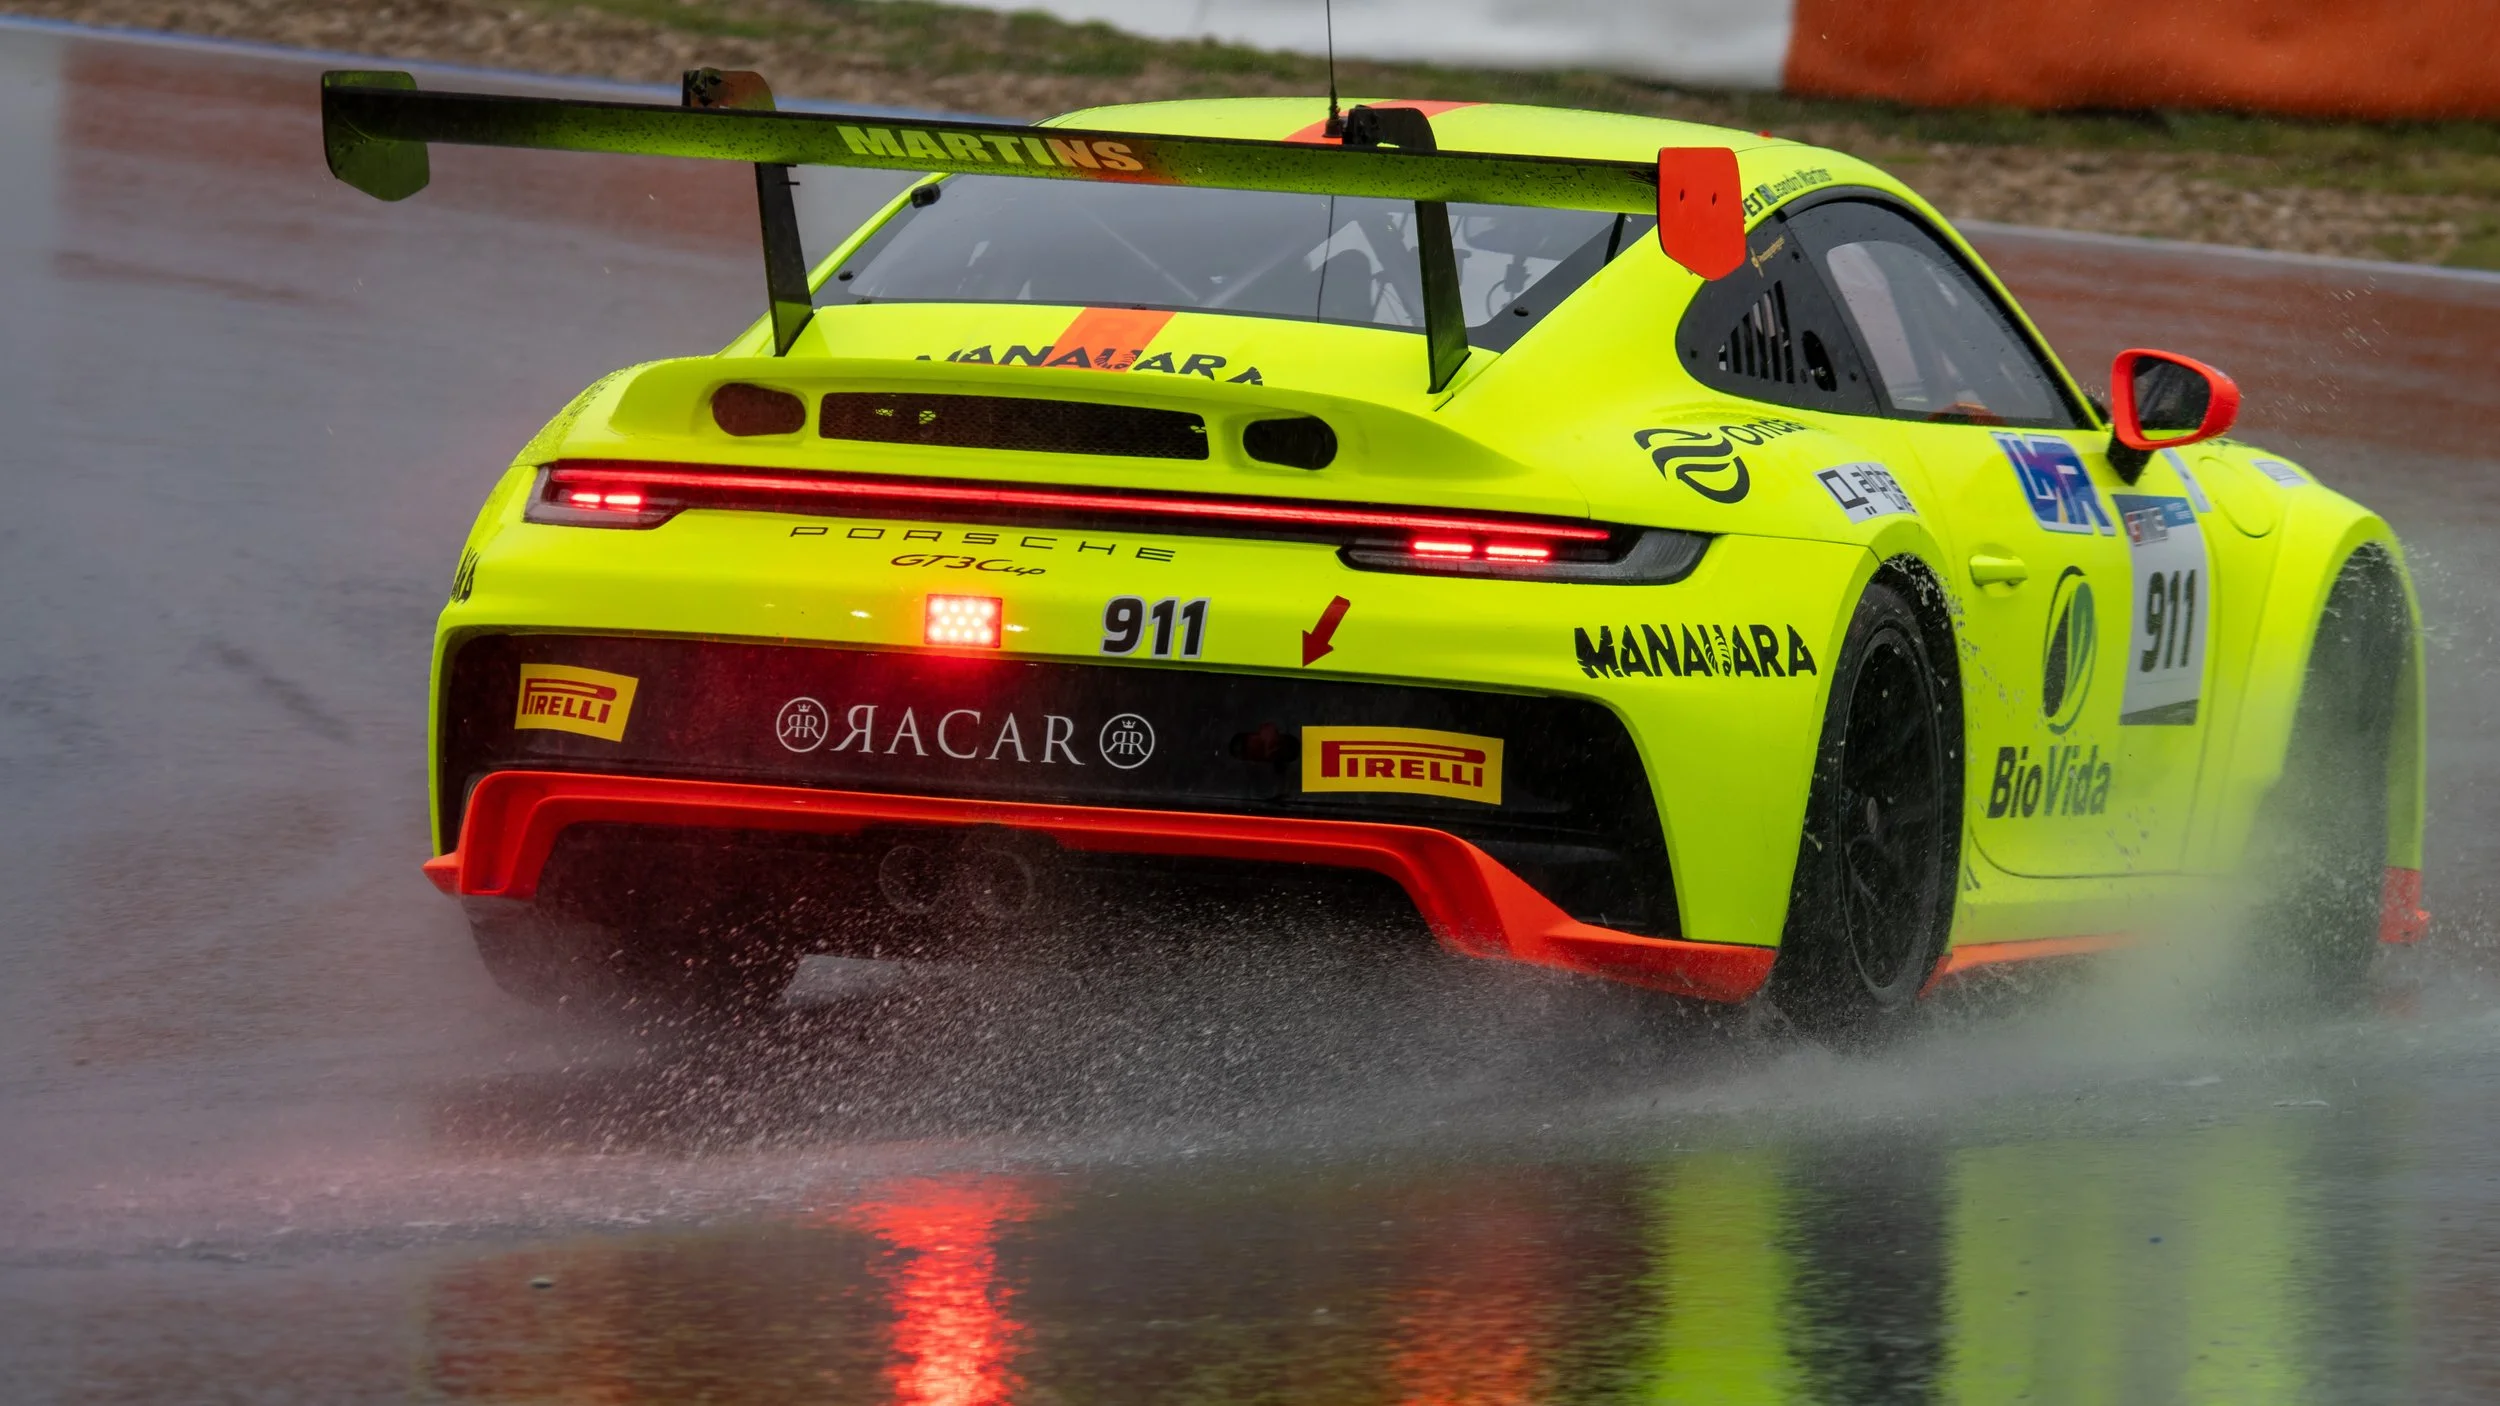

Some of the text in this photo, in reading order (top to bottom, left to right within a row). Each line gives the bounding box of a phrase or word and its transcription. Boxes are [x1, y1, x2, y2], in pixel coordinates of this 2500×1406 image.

[836, 125, 1144, 171] MARTINS
[790, 526, 1176, 563] PORSCHE
[1102, 595, 1211, 659] 911
[2140, 569, 2196, 672] 911
[521, 678, 617, 724] PIRELLI
[1321, 740, 1486, 788] PIRELLI
[1987, 745, 2111, 819] BioVida
